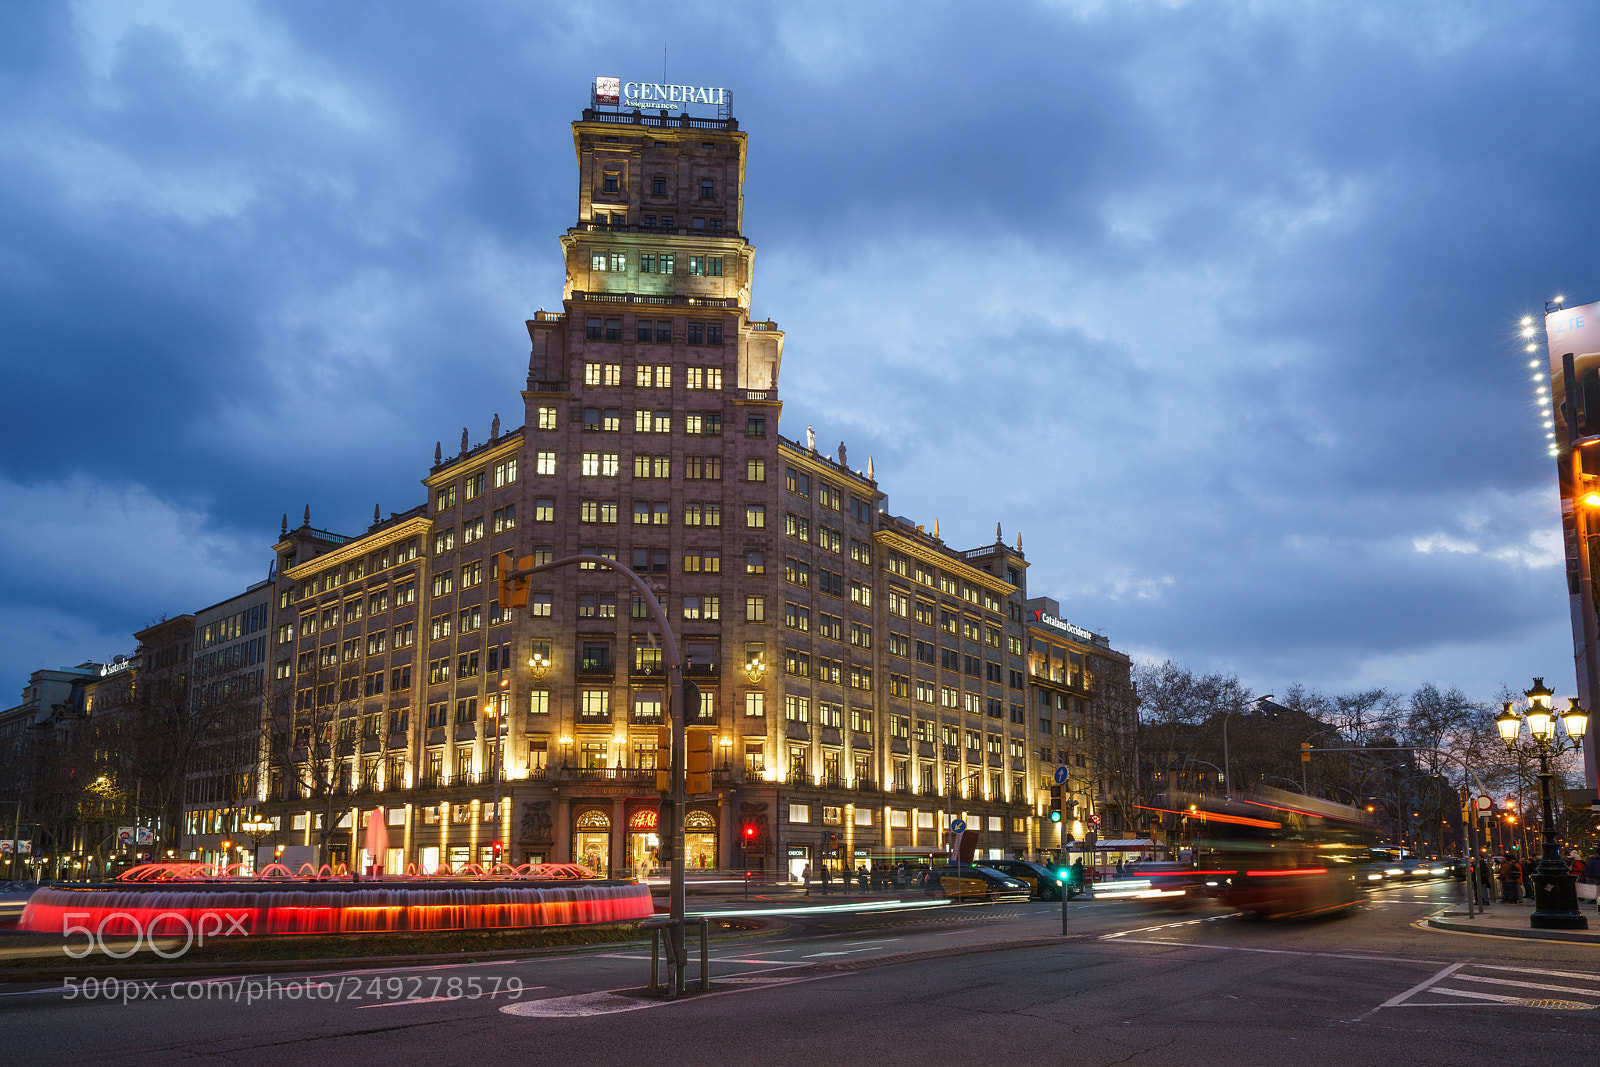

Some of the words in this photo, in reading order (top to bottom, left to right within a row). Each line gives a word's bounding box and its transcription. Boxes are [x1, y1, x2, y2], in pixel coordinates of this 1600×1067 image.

[624, 82, 725, 105] GENERALI
[624, 99, 678, 110] Assegurances
[1556, 315, 1585, 334] ZTE
[1042, 612, 1067, 631] Catalana
[634, 813, 657, 828] H&M
